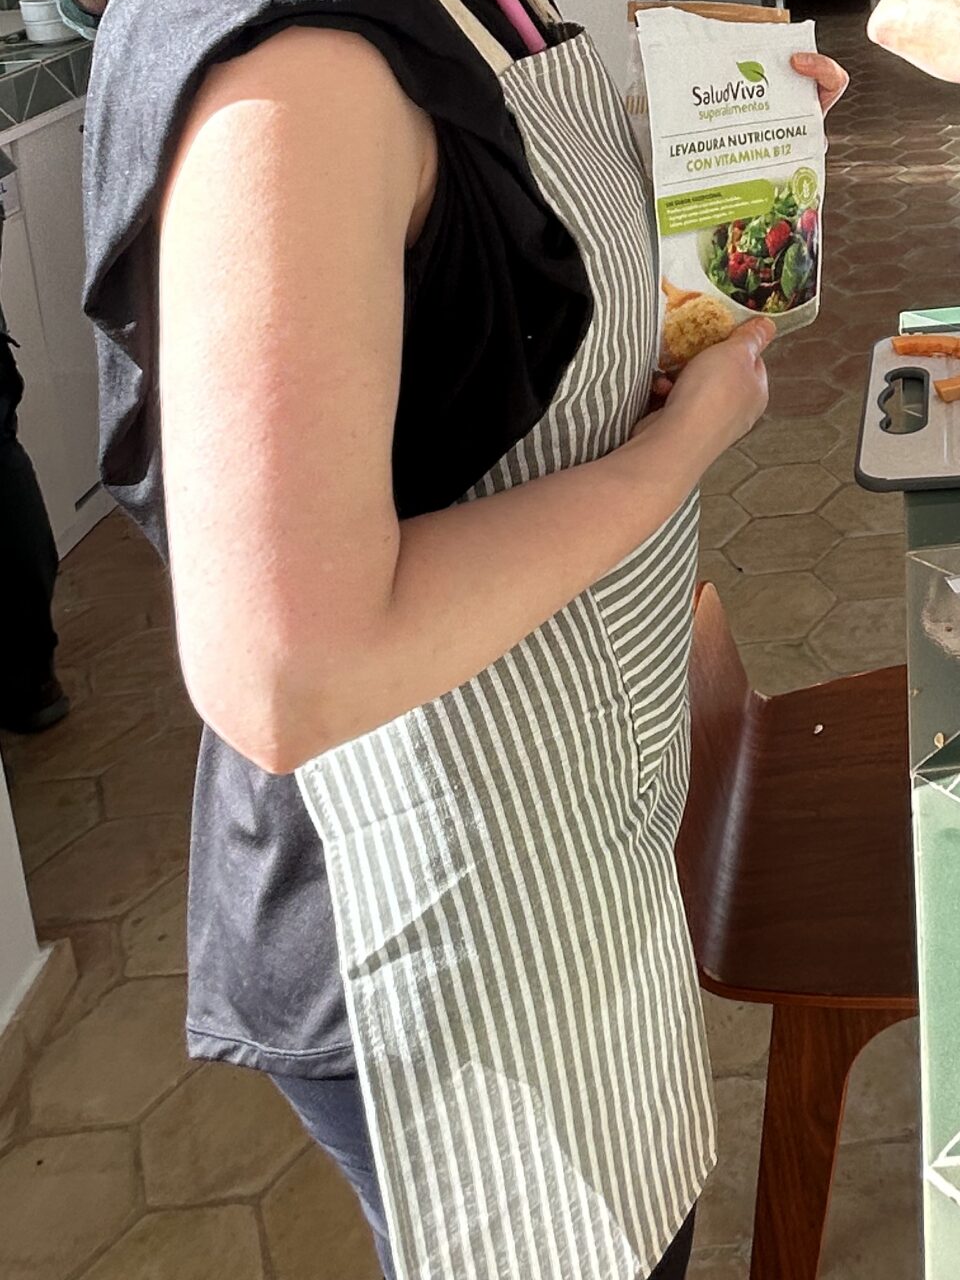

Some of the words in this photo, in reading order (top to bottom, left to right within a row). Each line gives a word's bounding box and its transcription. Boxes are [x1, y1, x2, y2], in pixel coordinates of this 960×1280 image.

[692, 80, 765, 107] SaludViva
[699, 101, 770, 122] superalimentos
[670, 137, 725, 158] LEVADURA
[727, 125, 807, 147] NUTRICIONAL
[686, 157, 712, 172] CON
[715, 149, 771, 168] VITAMINA
[773, 144, 792, 158] B12
